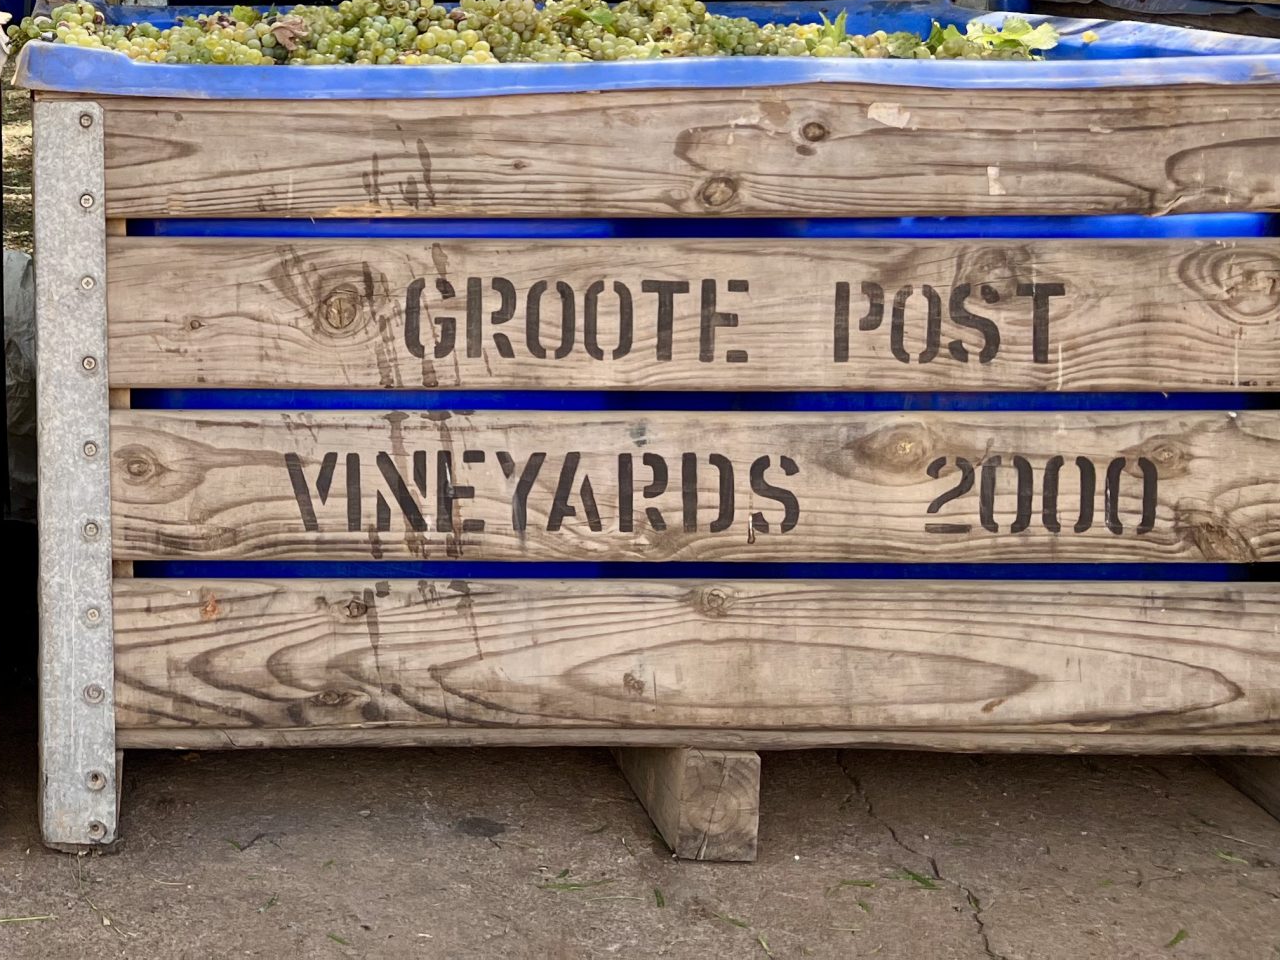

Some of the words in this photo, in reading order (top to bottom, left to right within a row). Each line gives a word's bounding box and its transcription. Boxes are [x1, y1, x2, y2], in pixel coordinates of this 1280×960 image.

[404, 275, 749, 364] GROOTE
[833, 280, 1067, 364] POST
[286, 450, 801, 536] VINEYARDS
[925, 455, 1160, 536] 2000
